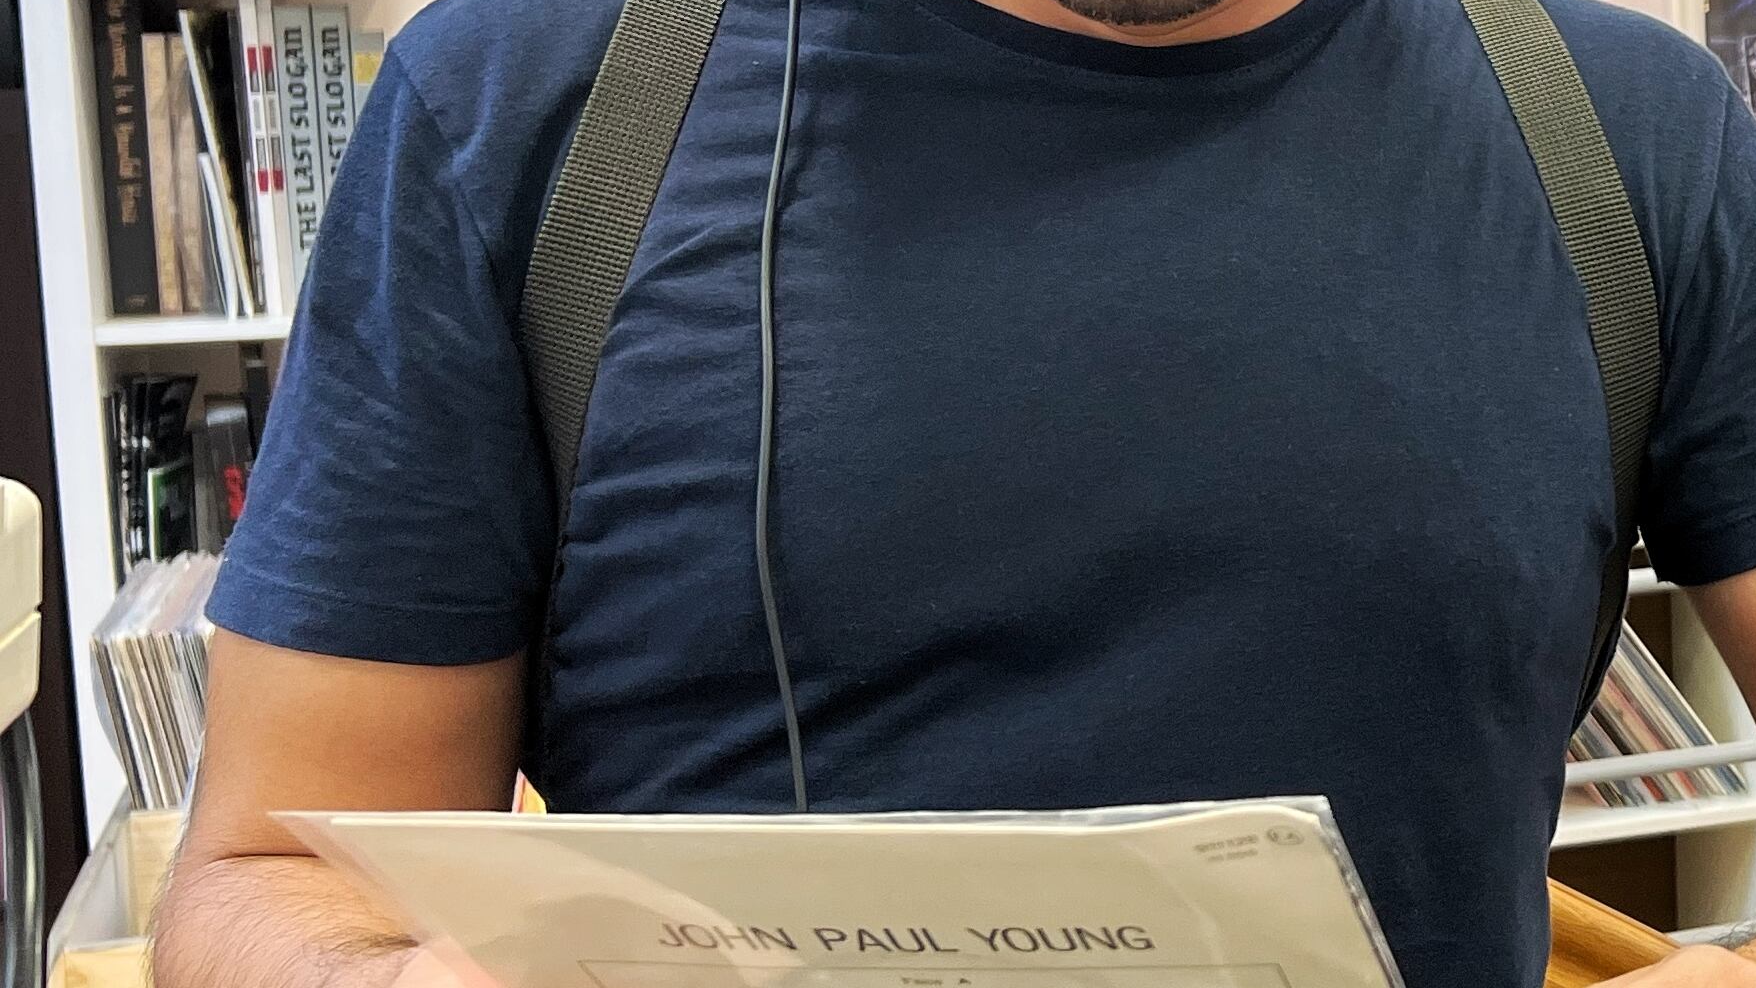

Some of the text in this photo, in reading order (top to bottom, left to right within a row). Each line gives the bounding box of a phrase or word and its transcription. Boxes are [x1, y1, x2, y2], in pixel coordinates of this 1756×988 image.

[321, 25, 347, 129] SLOGAN
[283, 27, 321, 250] THE LAST SLOGAN
[658, 923, 1157, 954] JOHN PAUL YOUNG
